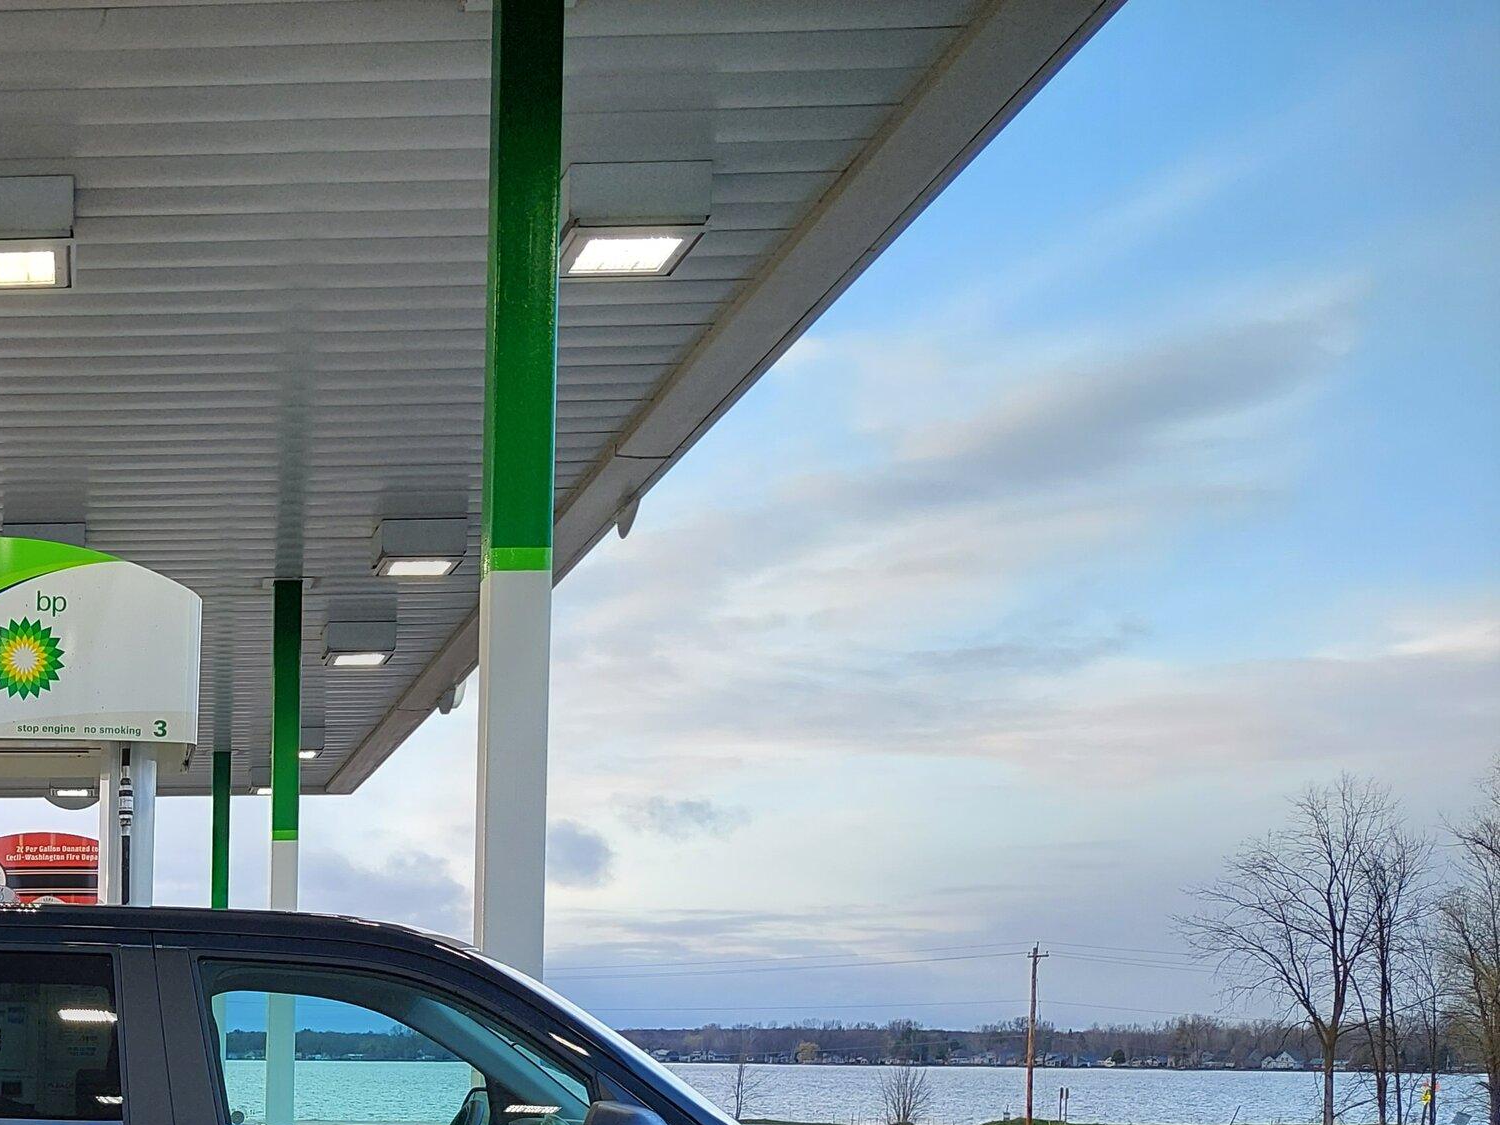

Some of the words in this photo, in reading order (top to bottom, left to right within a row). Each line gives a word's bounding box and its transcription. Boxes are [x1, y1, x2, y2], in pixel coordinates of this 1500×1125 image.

[36, 590, 67, 617] bp
[17, 724, 39, 734] stop
[42, 724, 76, 735] engine
[84, 725, 97, 734] no
[99, 725, 142, 736] smoking
[153, 720, 167, 737] 3
[39, 845, 61, 853] Gallon
